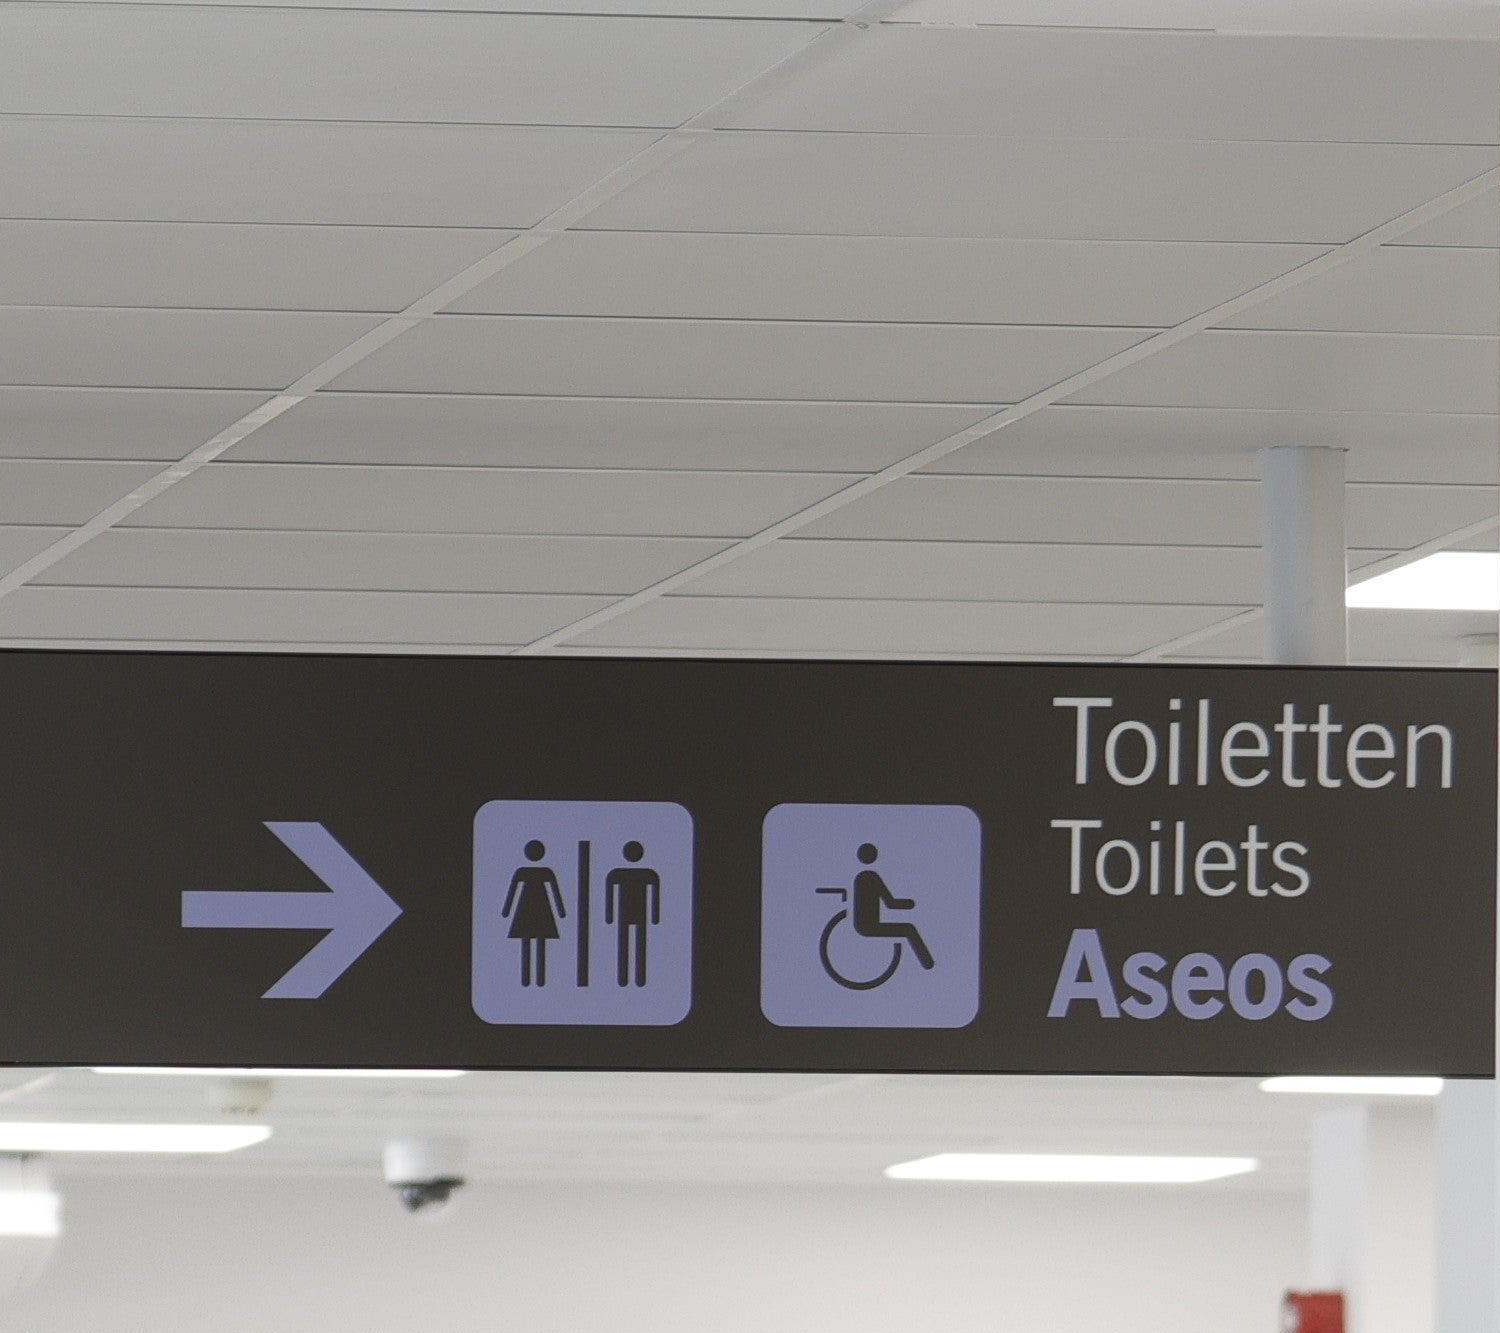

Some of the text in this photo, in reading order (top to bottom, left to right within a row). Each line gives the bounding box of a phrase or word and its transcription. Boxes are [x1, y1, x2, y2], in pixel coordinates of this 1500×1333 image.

[1051, 696, 1454, 790] Toiletten
[1049, 818, 1311, 899] Toilets
[1046, 927, 1335, 1022] Aseos
